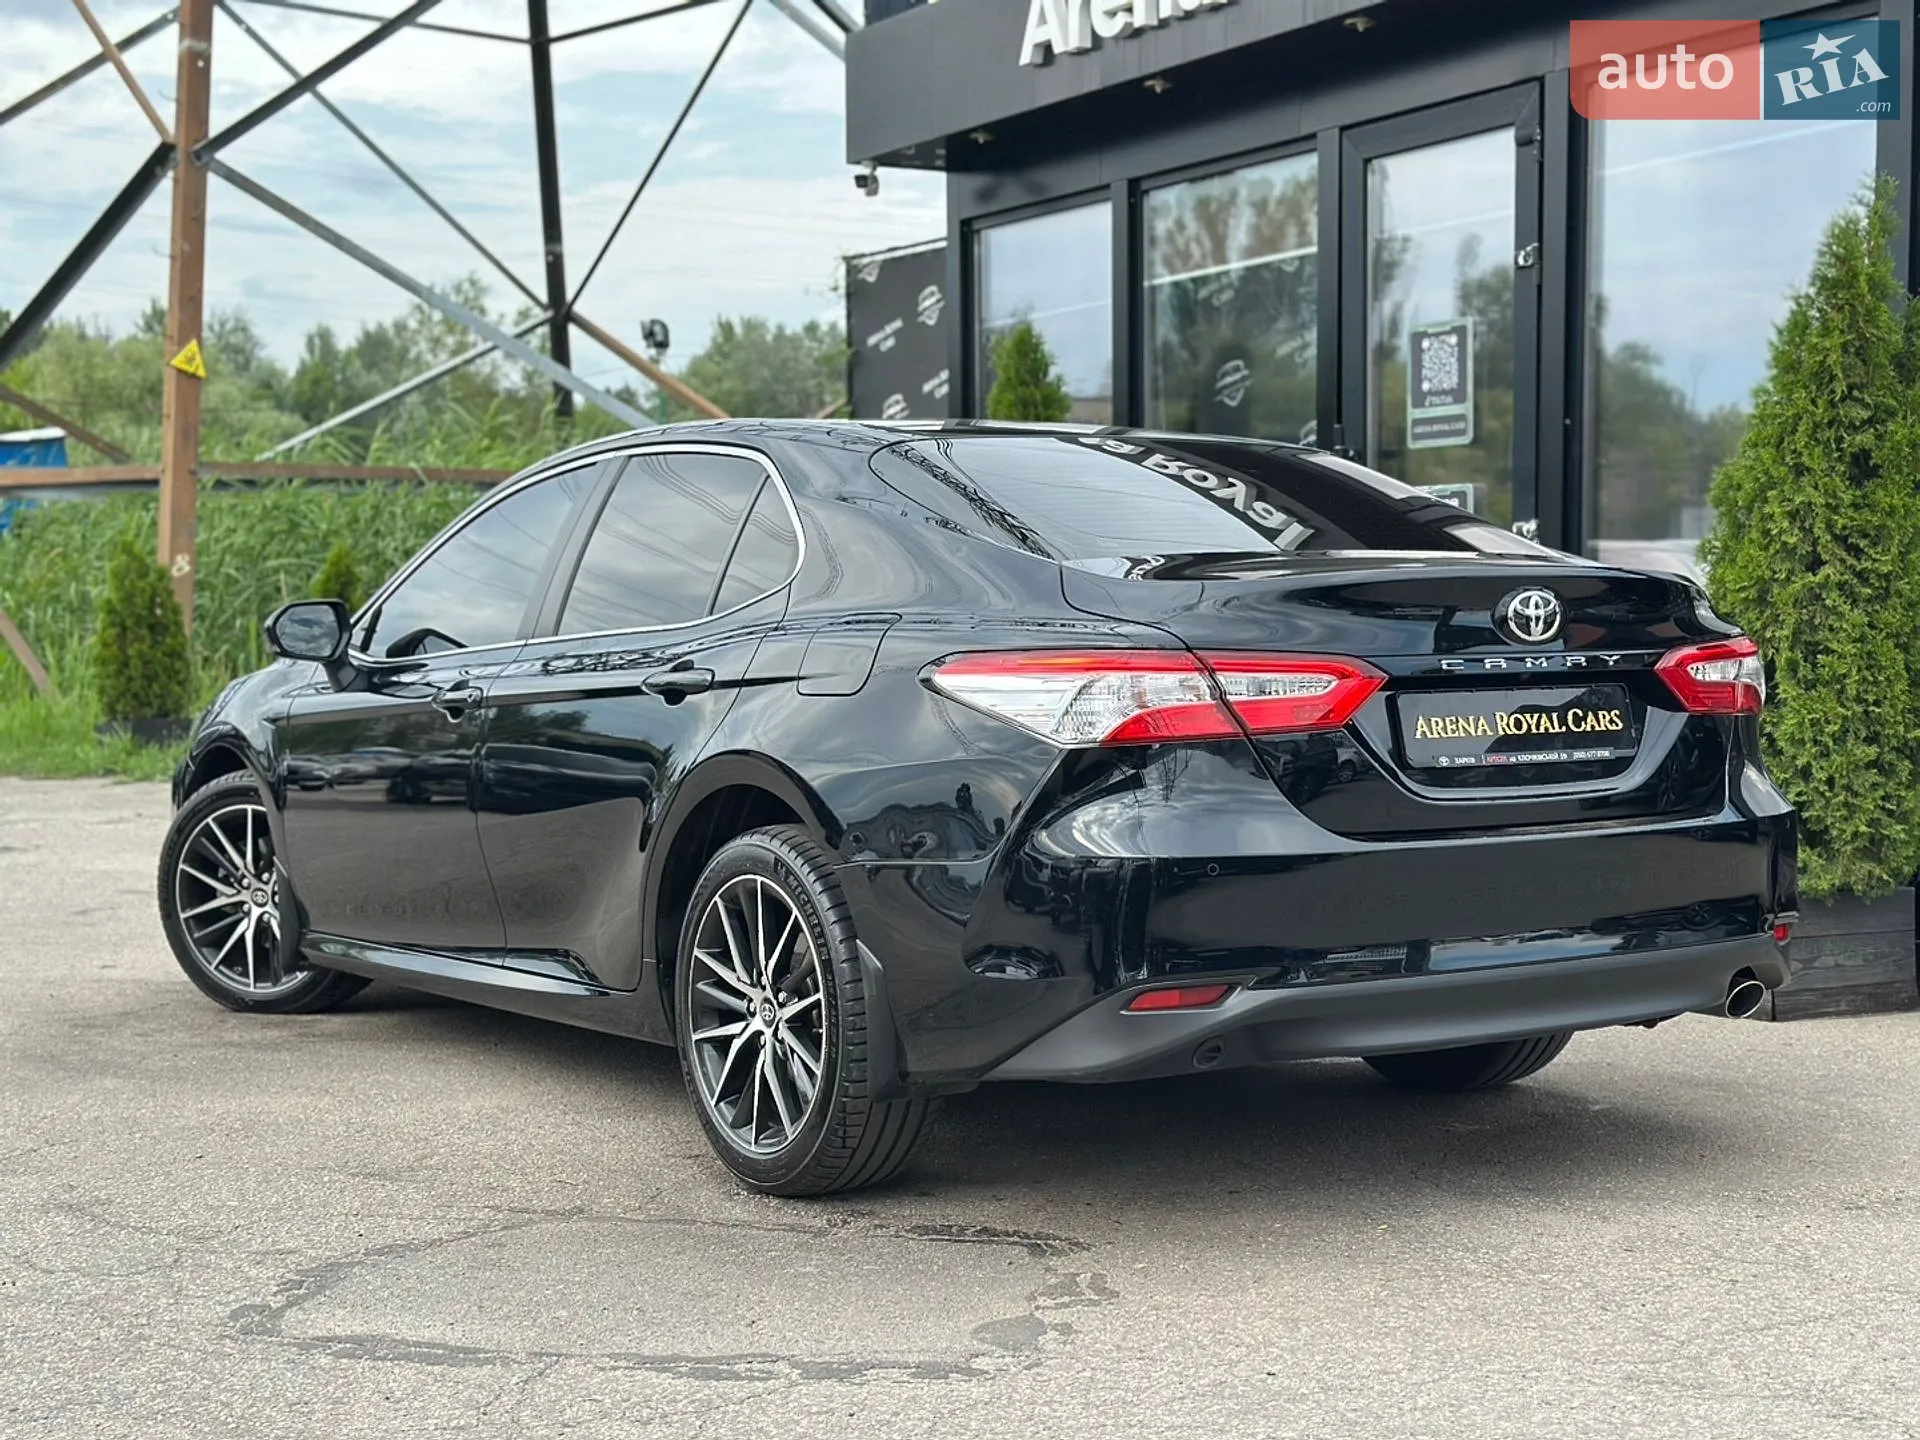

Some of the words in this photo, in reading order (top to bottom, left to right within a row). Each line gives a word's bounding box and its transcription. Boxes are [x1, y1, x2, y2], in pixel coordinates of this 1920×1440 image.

[1441, 655, 1621, 670] CAMRY
[1415, 716, 1493, 739] ARENA
[1494, 710, 1566, 736] ROYAL
[1567, 708, 1623, 732] CARS
